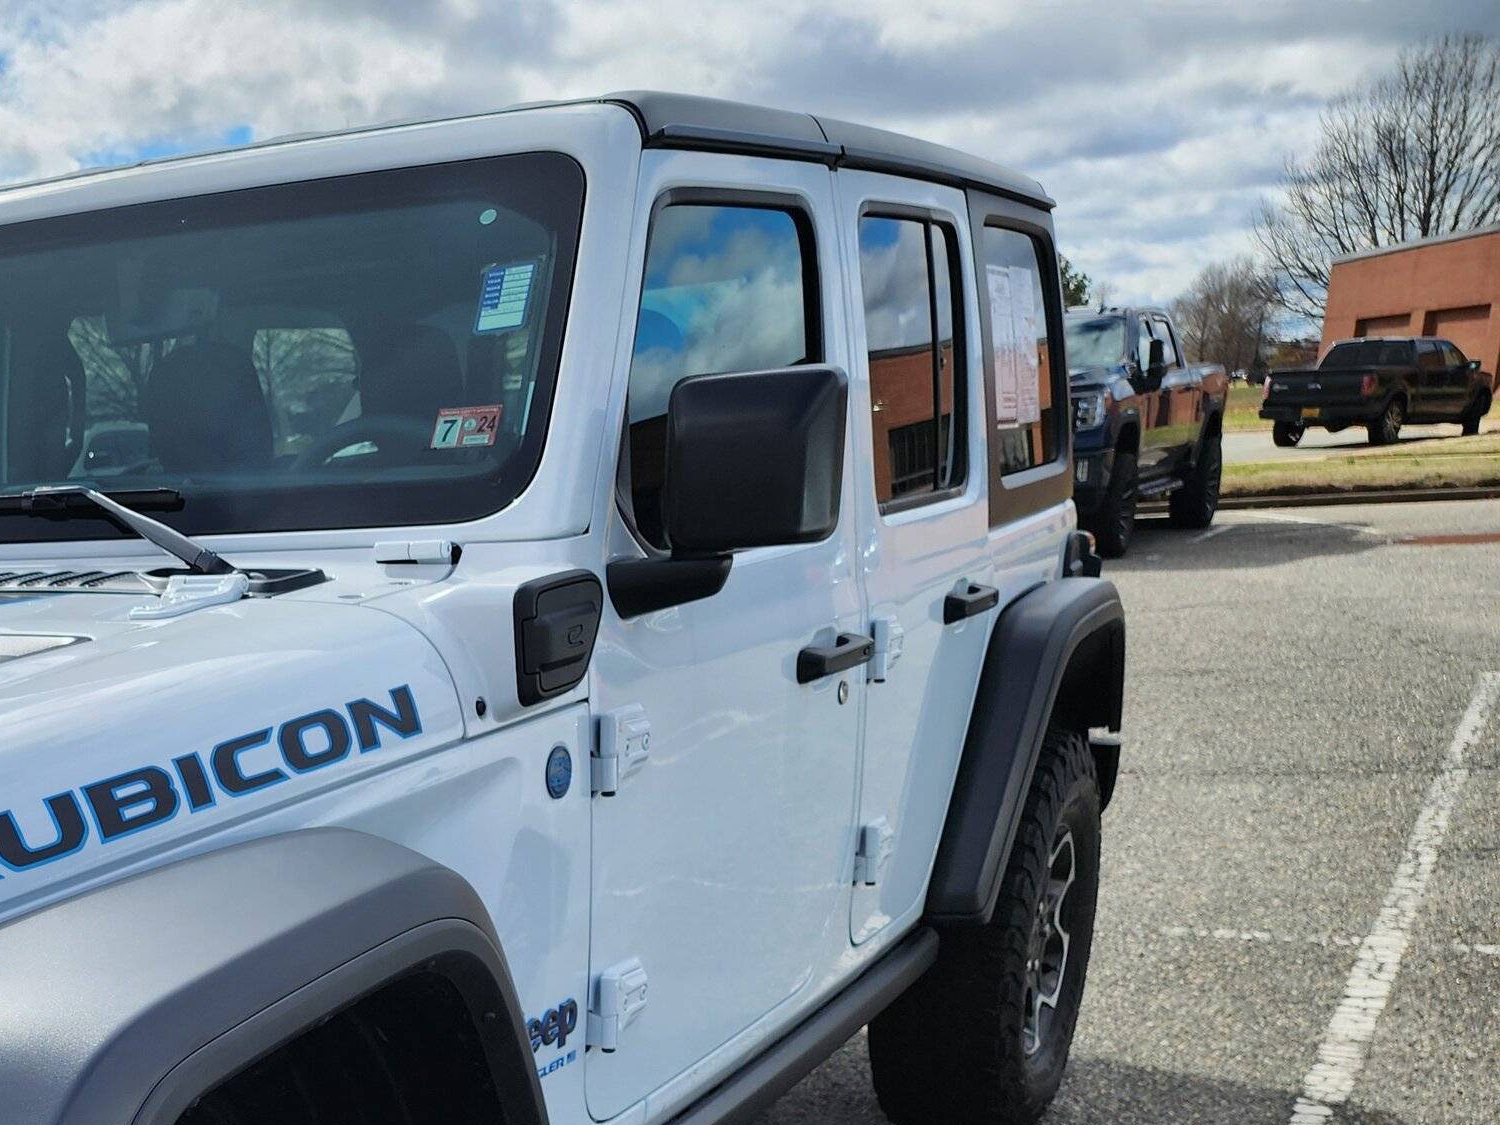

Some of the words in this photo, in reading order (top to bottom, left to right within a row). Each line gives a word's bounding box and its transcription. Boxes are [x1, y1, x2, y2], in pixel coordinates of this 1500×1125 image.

[442, 419, 458, 442] 7
[477, 416, 496, 433] 24
[526, 998, 578, 1053] eep
